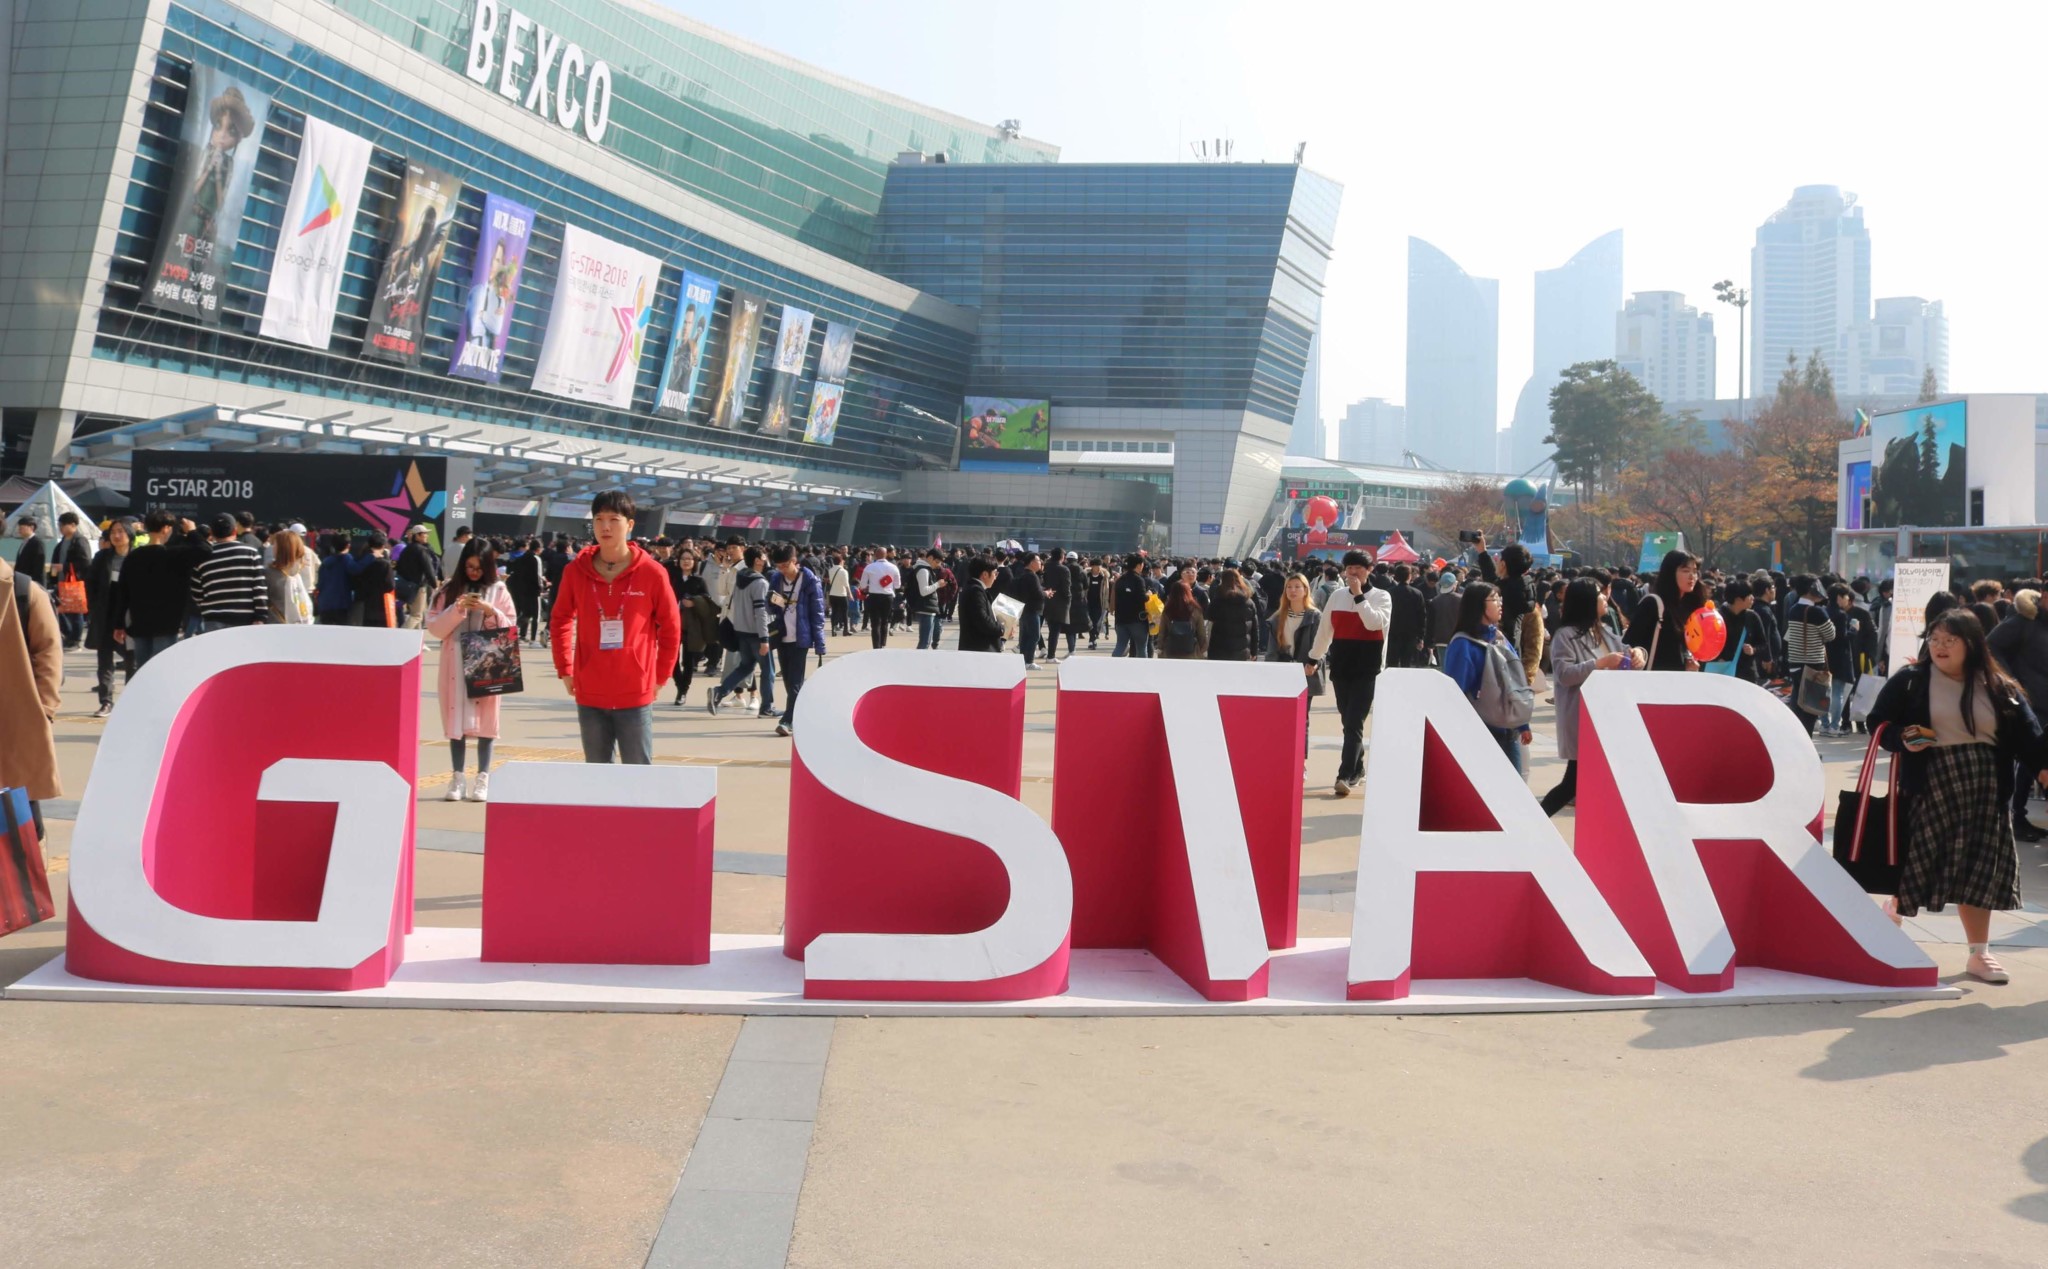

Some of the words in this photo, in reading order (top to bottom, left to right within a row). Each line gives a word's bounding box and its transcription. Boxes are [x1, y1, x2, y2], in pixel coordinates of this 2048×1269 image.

[466, 0, 611, 143] BEXCO
[570, 251, 602, 279] G-STAR
[603, 264, 628, 287] 2018
[147, 478, 208, 497] G-STAR
[211, 479, 253, 498] 2018
[68, 624, 1938, 999] G-STAR
